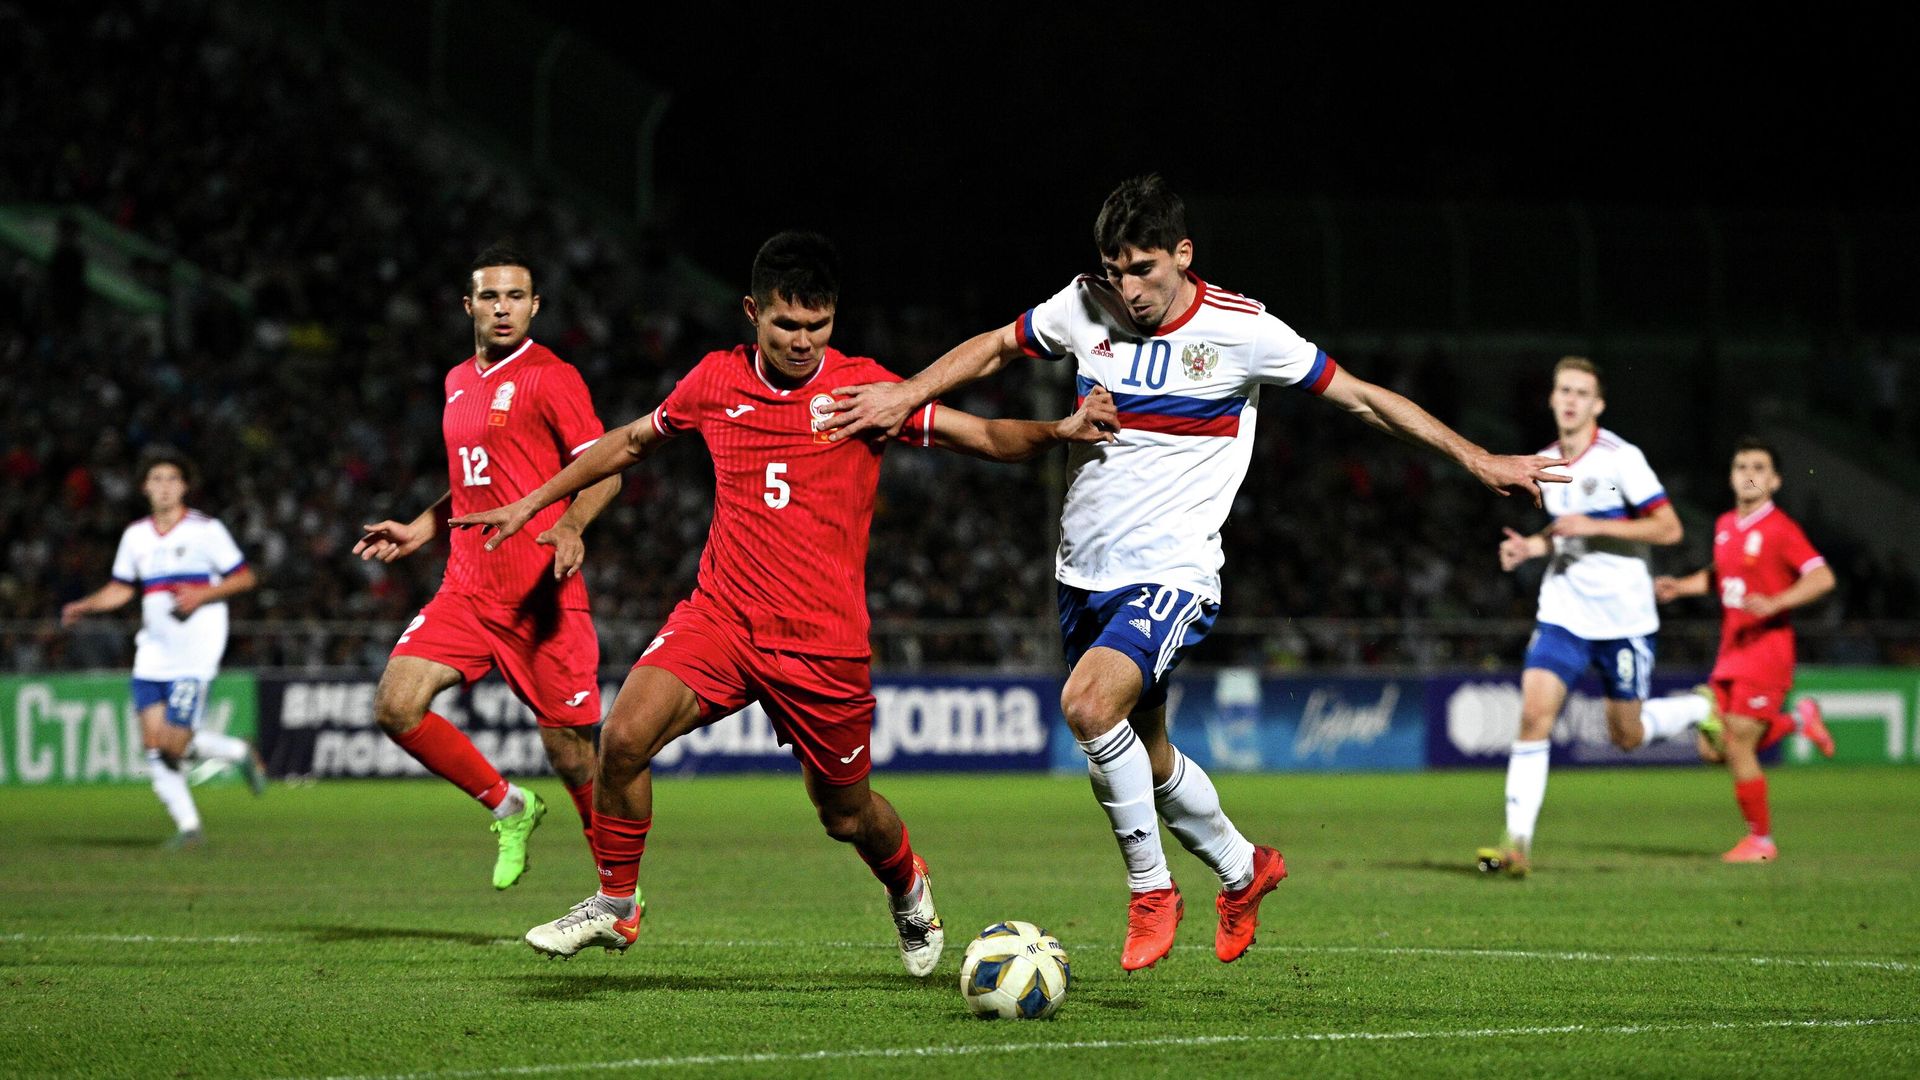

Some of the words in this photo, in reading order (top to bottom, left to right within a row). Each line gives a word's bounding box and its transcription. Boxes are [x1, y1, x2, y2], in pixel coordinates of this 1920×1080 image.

[1090, 348, 1114, 359] adidas
[1122, 337, 1172, 390] 10
[458, 445, 492, 487] 12
[763, 462, 791, 509] 5
[1128, 619, 1152, 639] adidas
